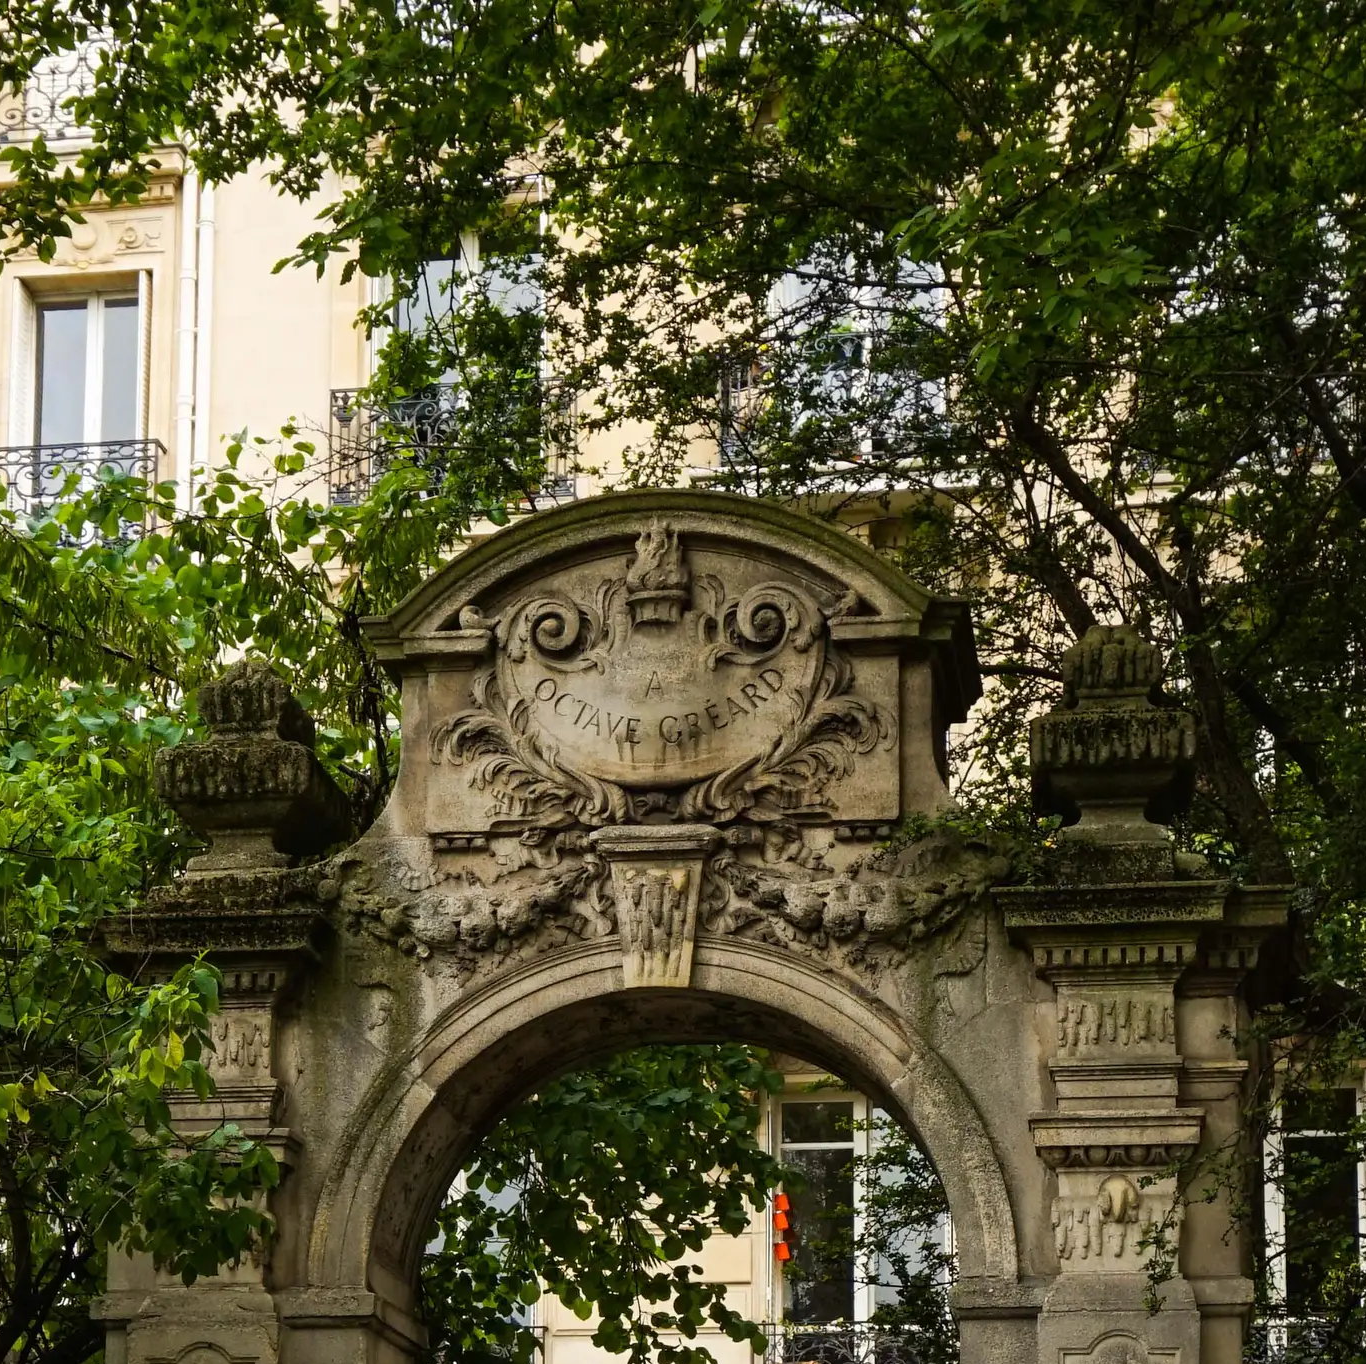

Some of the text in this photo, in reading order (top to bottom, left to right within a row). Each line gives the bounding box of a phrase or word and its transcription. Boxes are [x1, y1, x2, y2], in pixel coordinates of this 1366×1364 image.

[534, 668, 785, 745] OCTAVE GRÉARD
[645, 671, 665, 698] A
